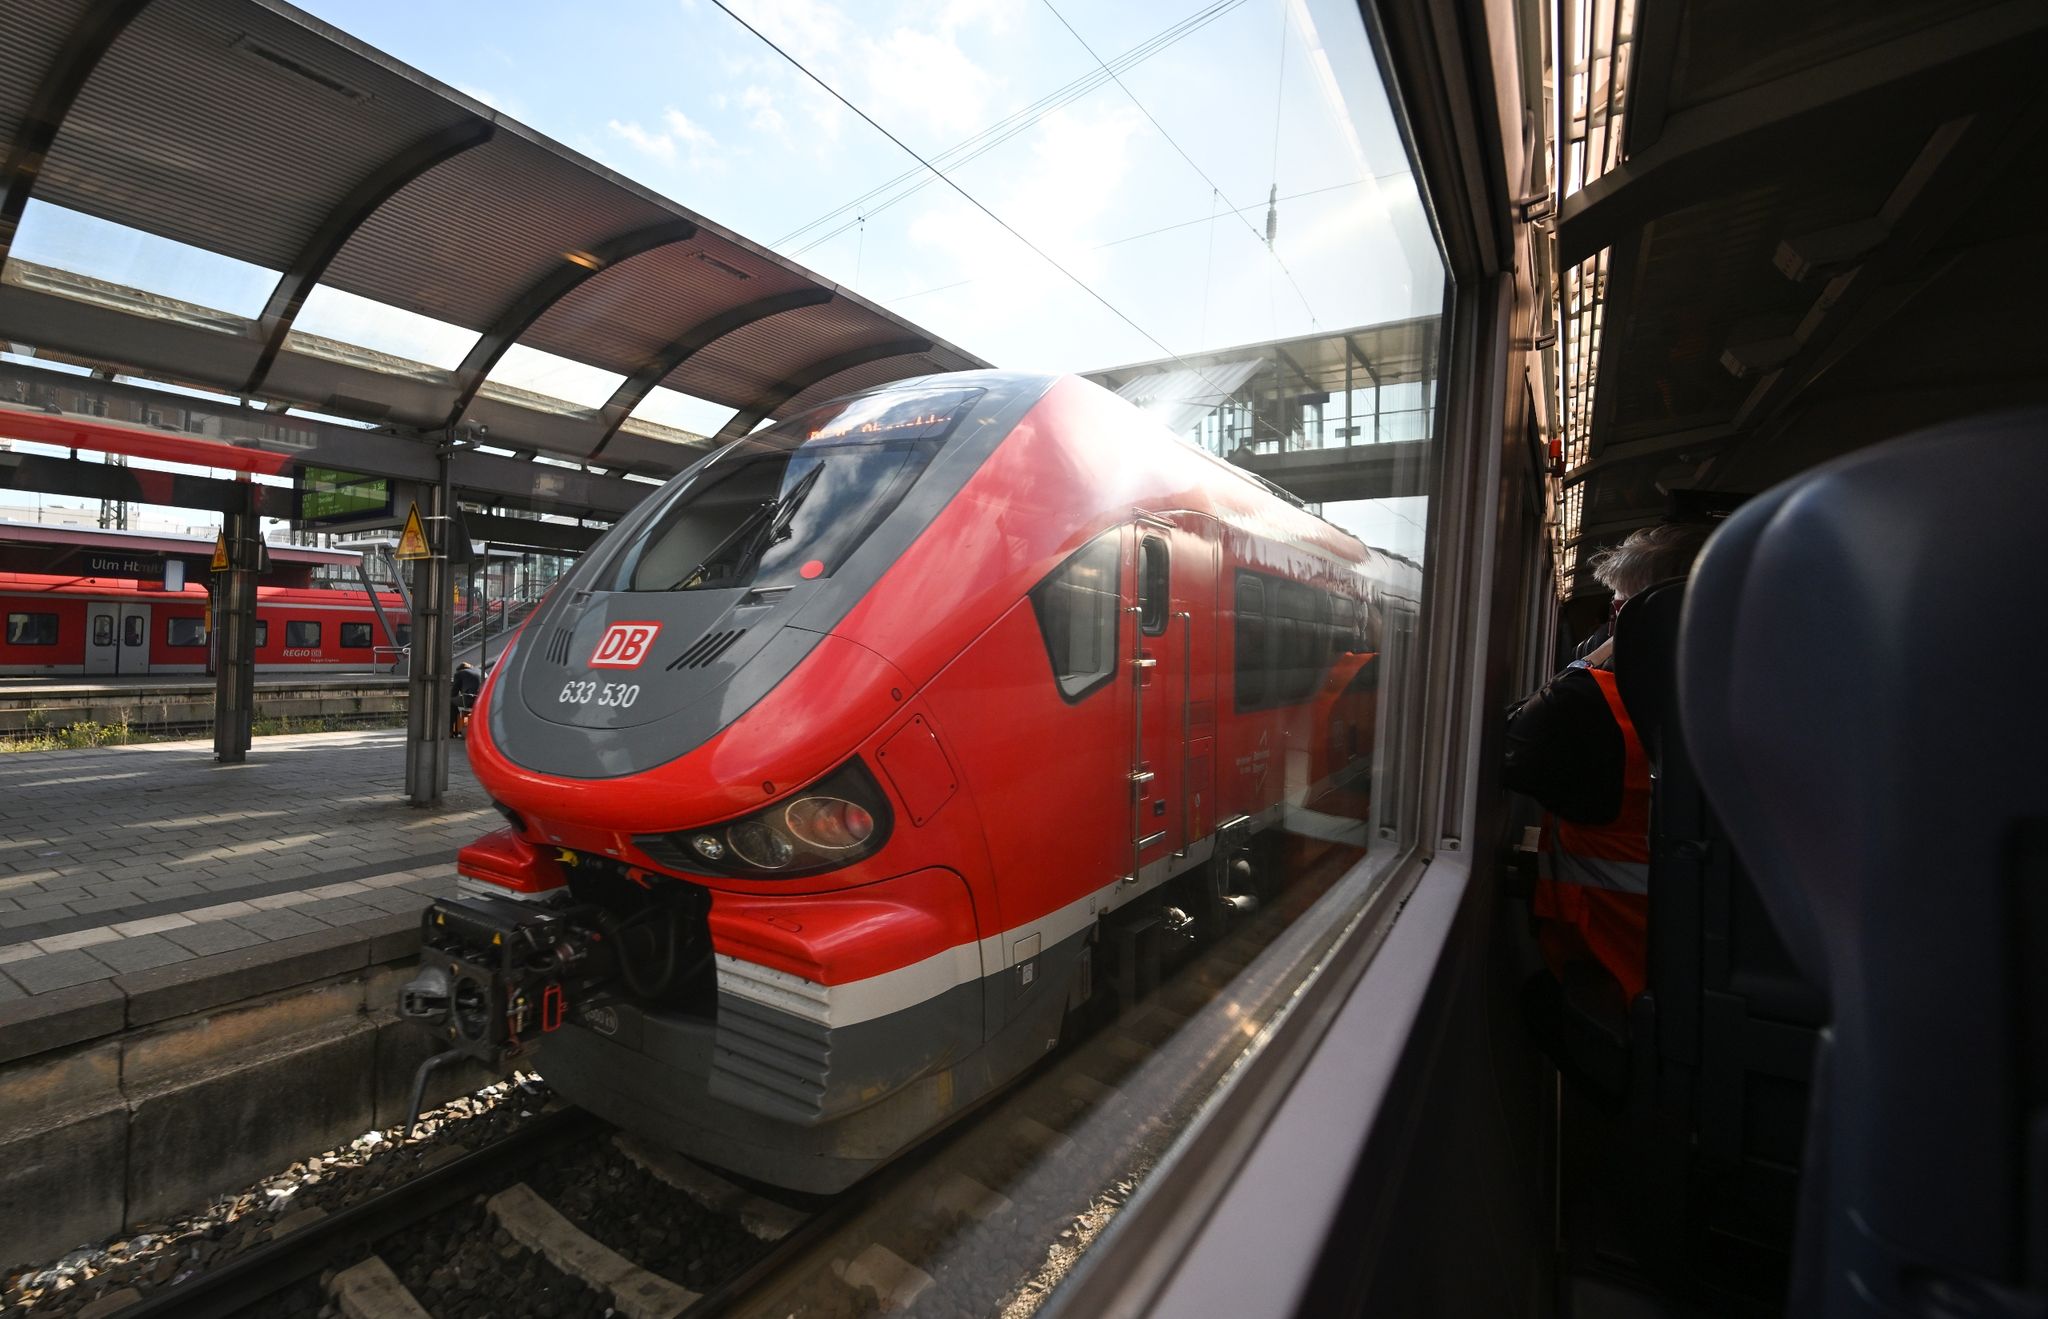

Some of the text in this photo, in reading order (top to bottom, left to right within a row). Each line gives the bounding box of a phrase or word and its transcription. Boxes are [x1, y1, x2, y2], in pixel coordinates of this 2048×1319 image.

[92, 558, 119, 571] Ulm
[282, 648, 310, 657] REGIO
[596, 628, 650, 661] DB
[558, 680, 640, 708] 633 530
